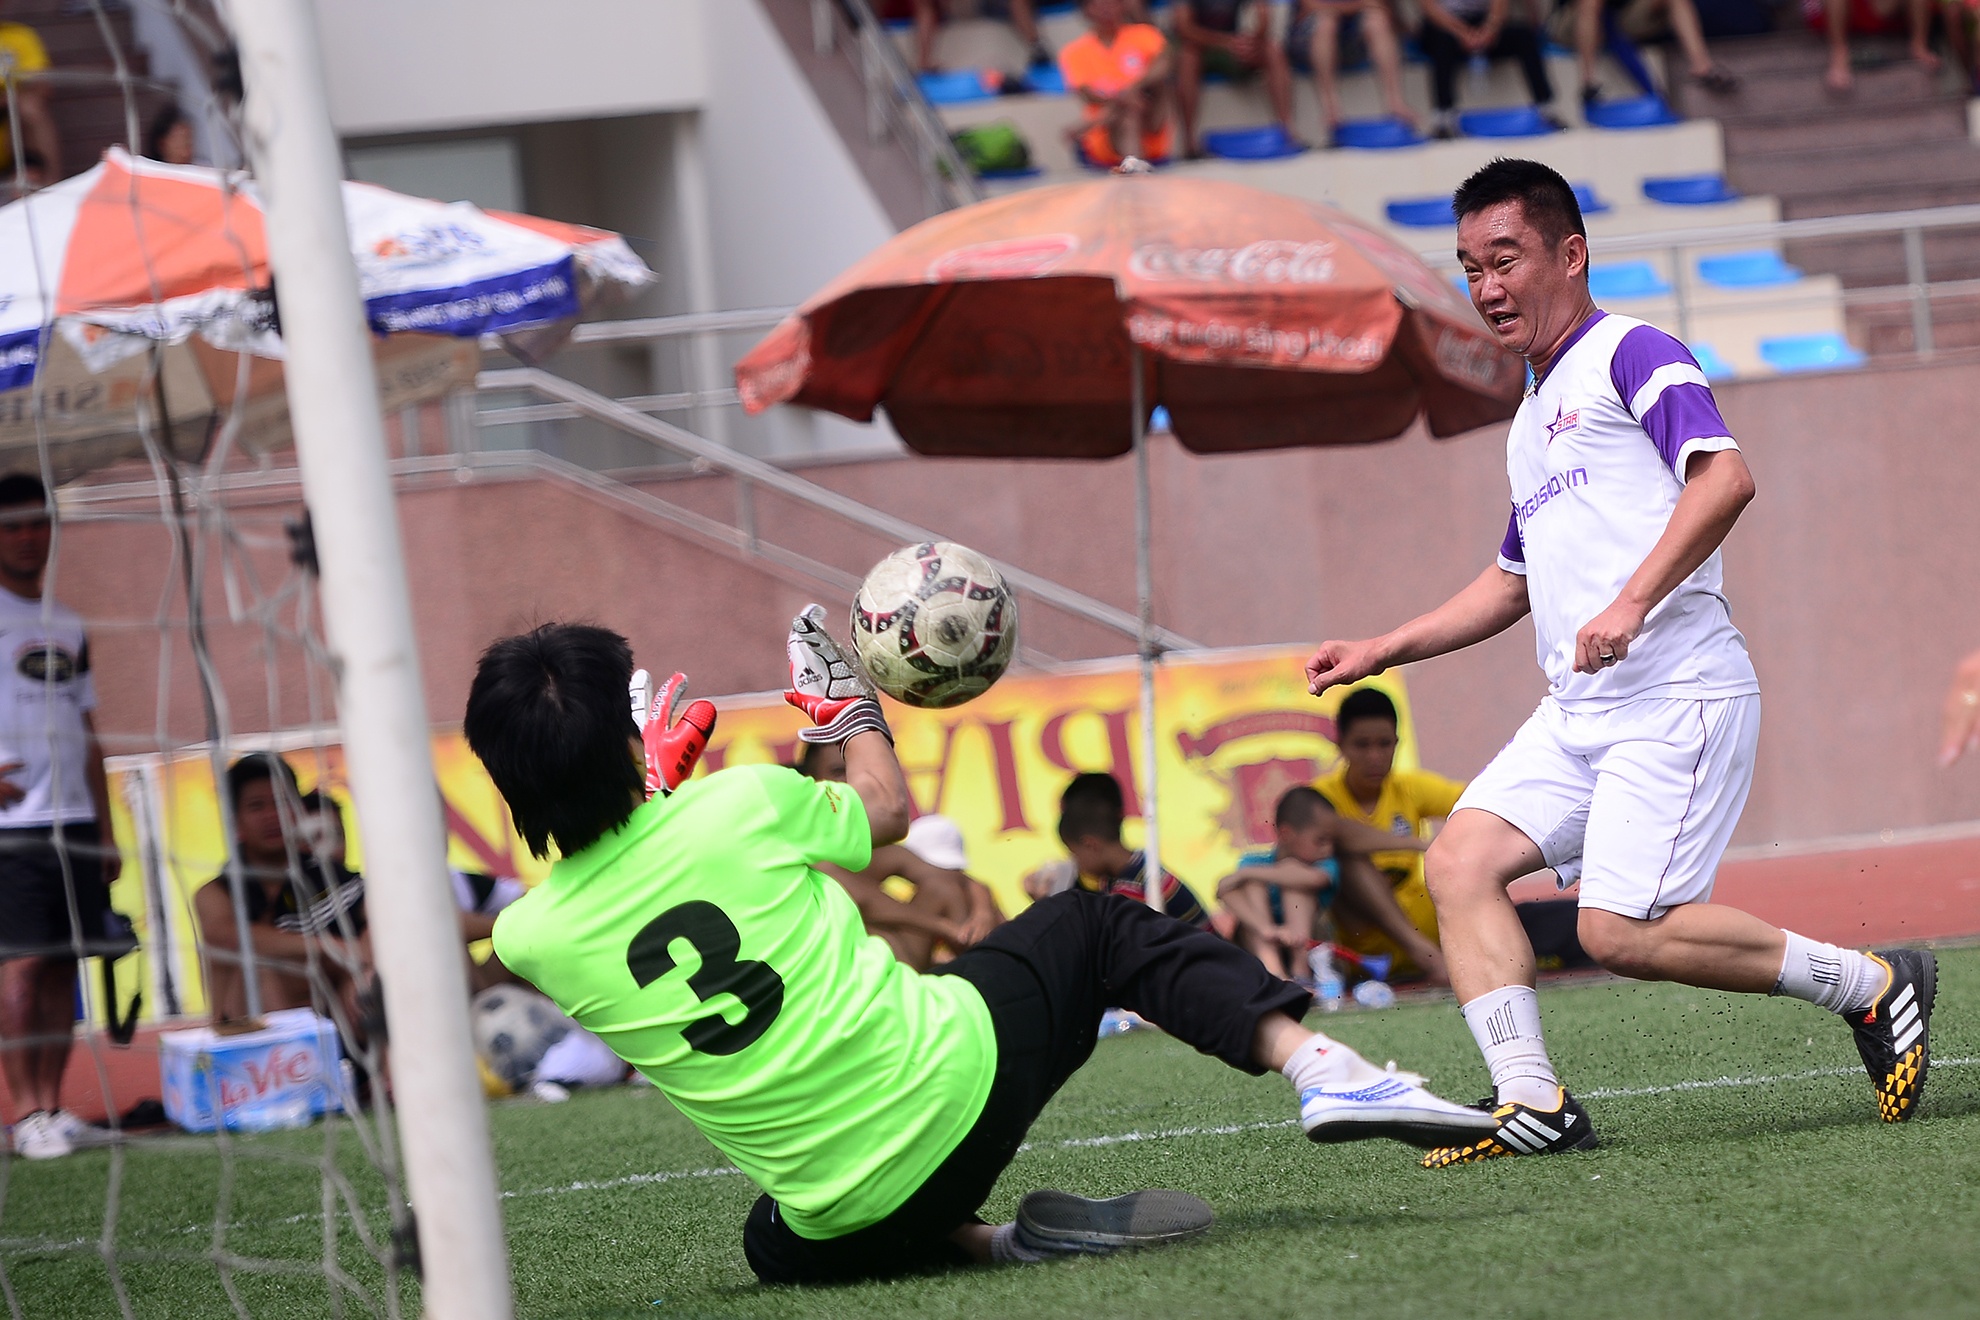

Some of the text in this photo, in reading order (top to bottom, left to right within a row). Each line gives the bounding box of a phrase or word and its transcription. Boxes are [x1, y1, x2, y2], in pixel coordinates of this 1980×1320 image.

[1130, 239, 1335, 283] Coca-Cola
[1557, 413, 1577, 430] STAR
[798, 673, 823, 687] adidas
[626, 900, 785, 1055] 3
